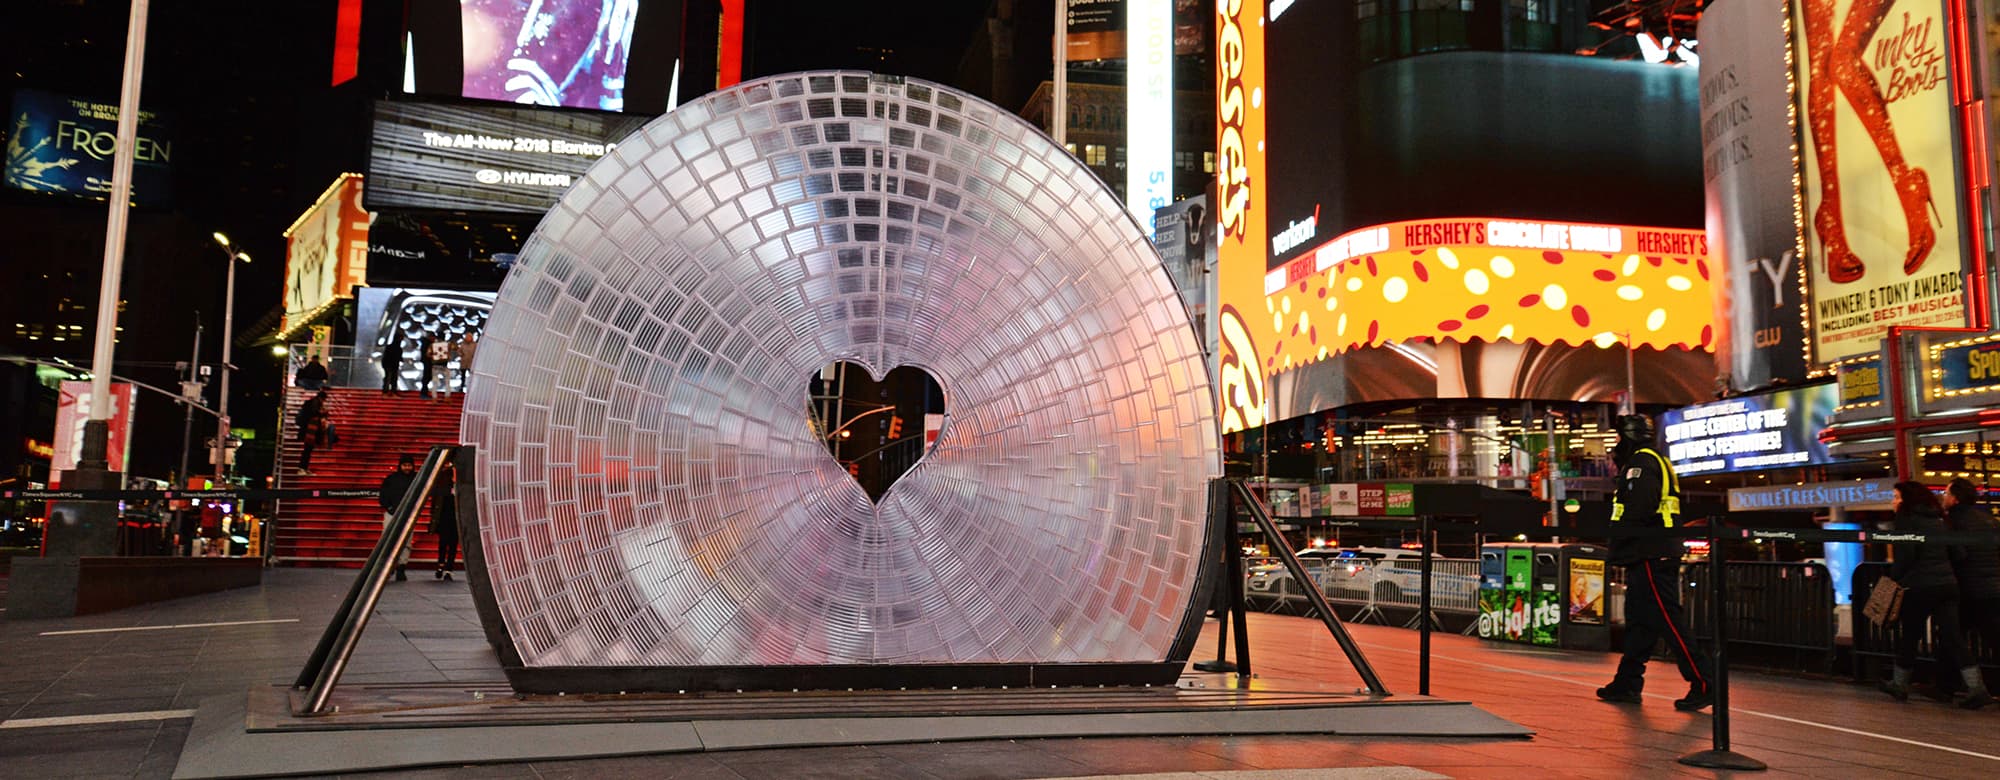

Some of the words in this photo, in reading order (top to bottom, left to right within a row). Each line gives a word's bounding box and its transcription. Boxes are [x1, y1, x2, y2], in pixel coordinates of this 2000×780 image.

[1884, 53, 1947, 103] Boots
[56, 120, 171, 162] FROEN
[423, 132, 452, 147] The
[453, 134, 514, 151] All-New
[514, 137, 550, 152] 2018
[551, 140, 604, 156] Elantra
[503, 171, 570, 187] HYUNDAI
[1156, 213, 1181, 229] HELP
[1405, 222, 1484, 247] HERSHEY'S
[1487, 220, 1569, 249] CHOCOLATE
[1570, 225, 1622, 252] WORLD
[1637, 230, 1708, 256] HERSHEY'S
[1820, 293, 1867, 319] WINNER!
[1870, 289, 1877, 309] 6
[1879, 281, 1911, 306] TONY
[1821, 311, 1872, 332] INCLUDING
[1873, 305, 1904, 322] BEST
[1747, 411, 1764, 430] OF
[1360, 489, 1384, 497] STEP
